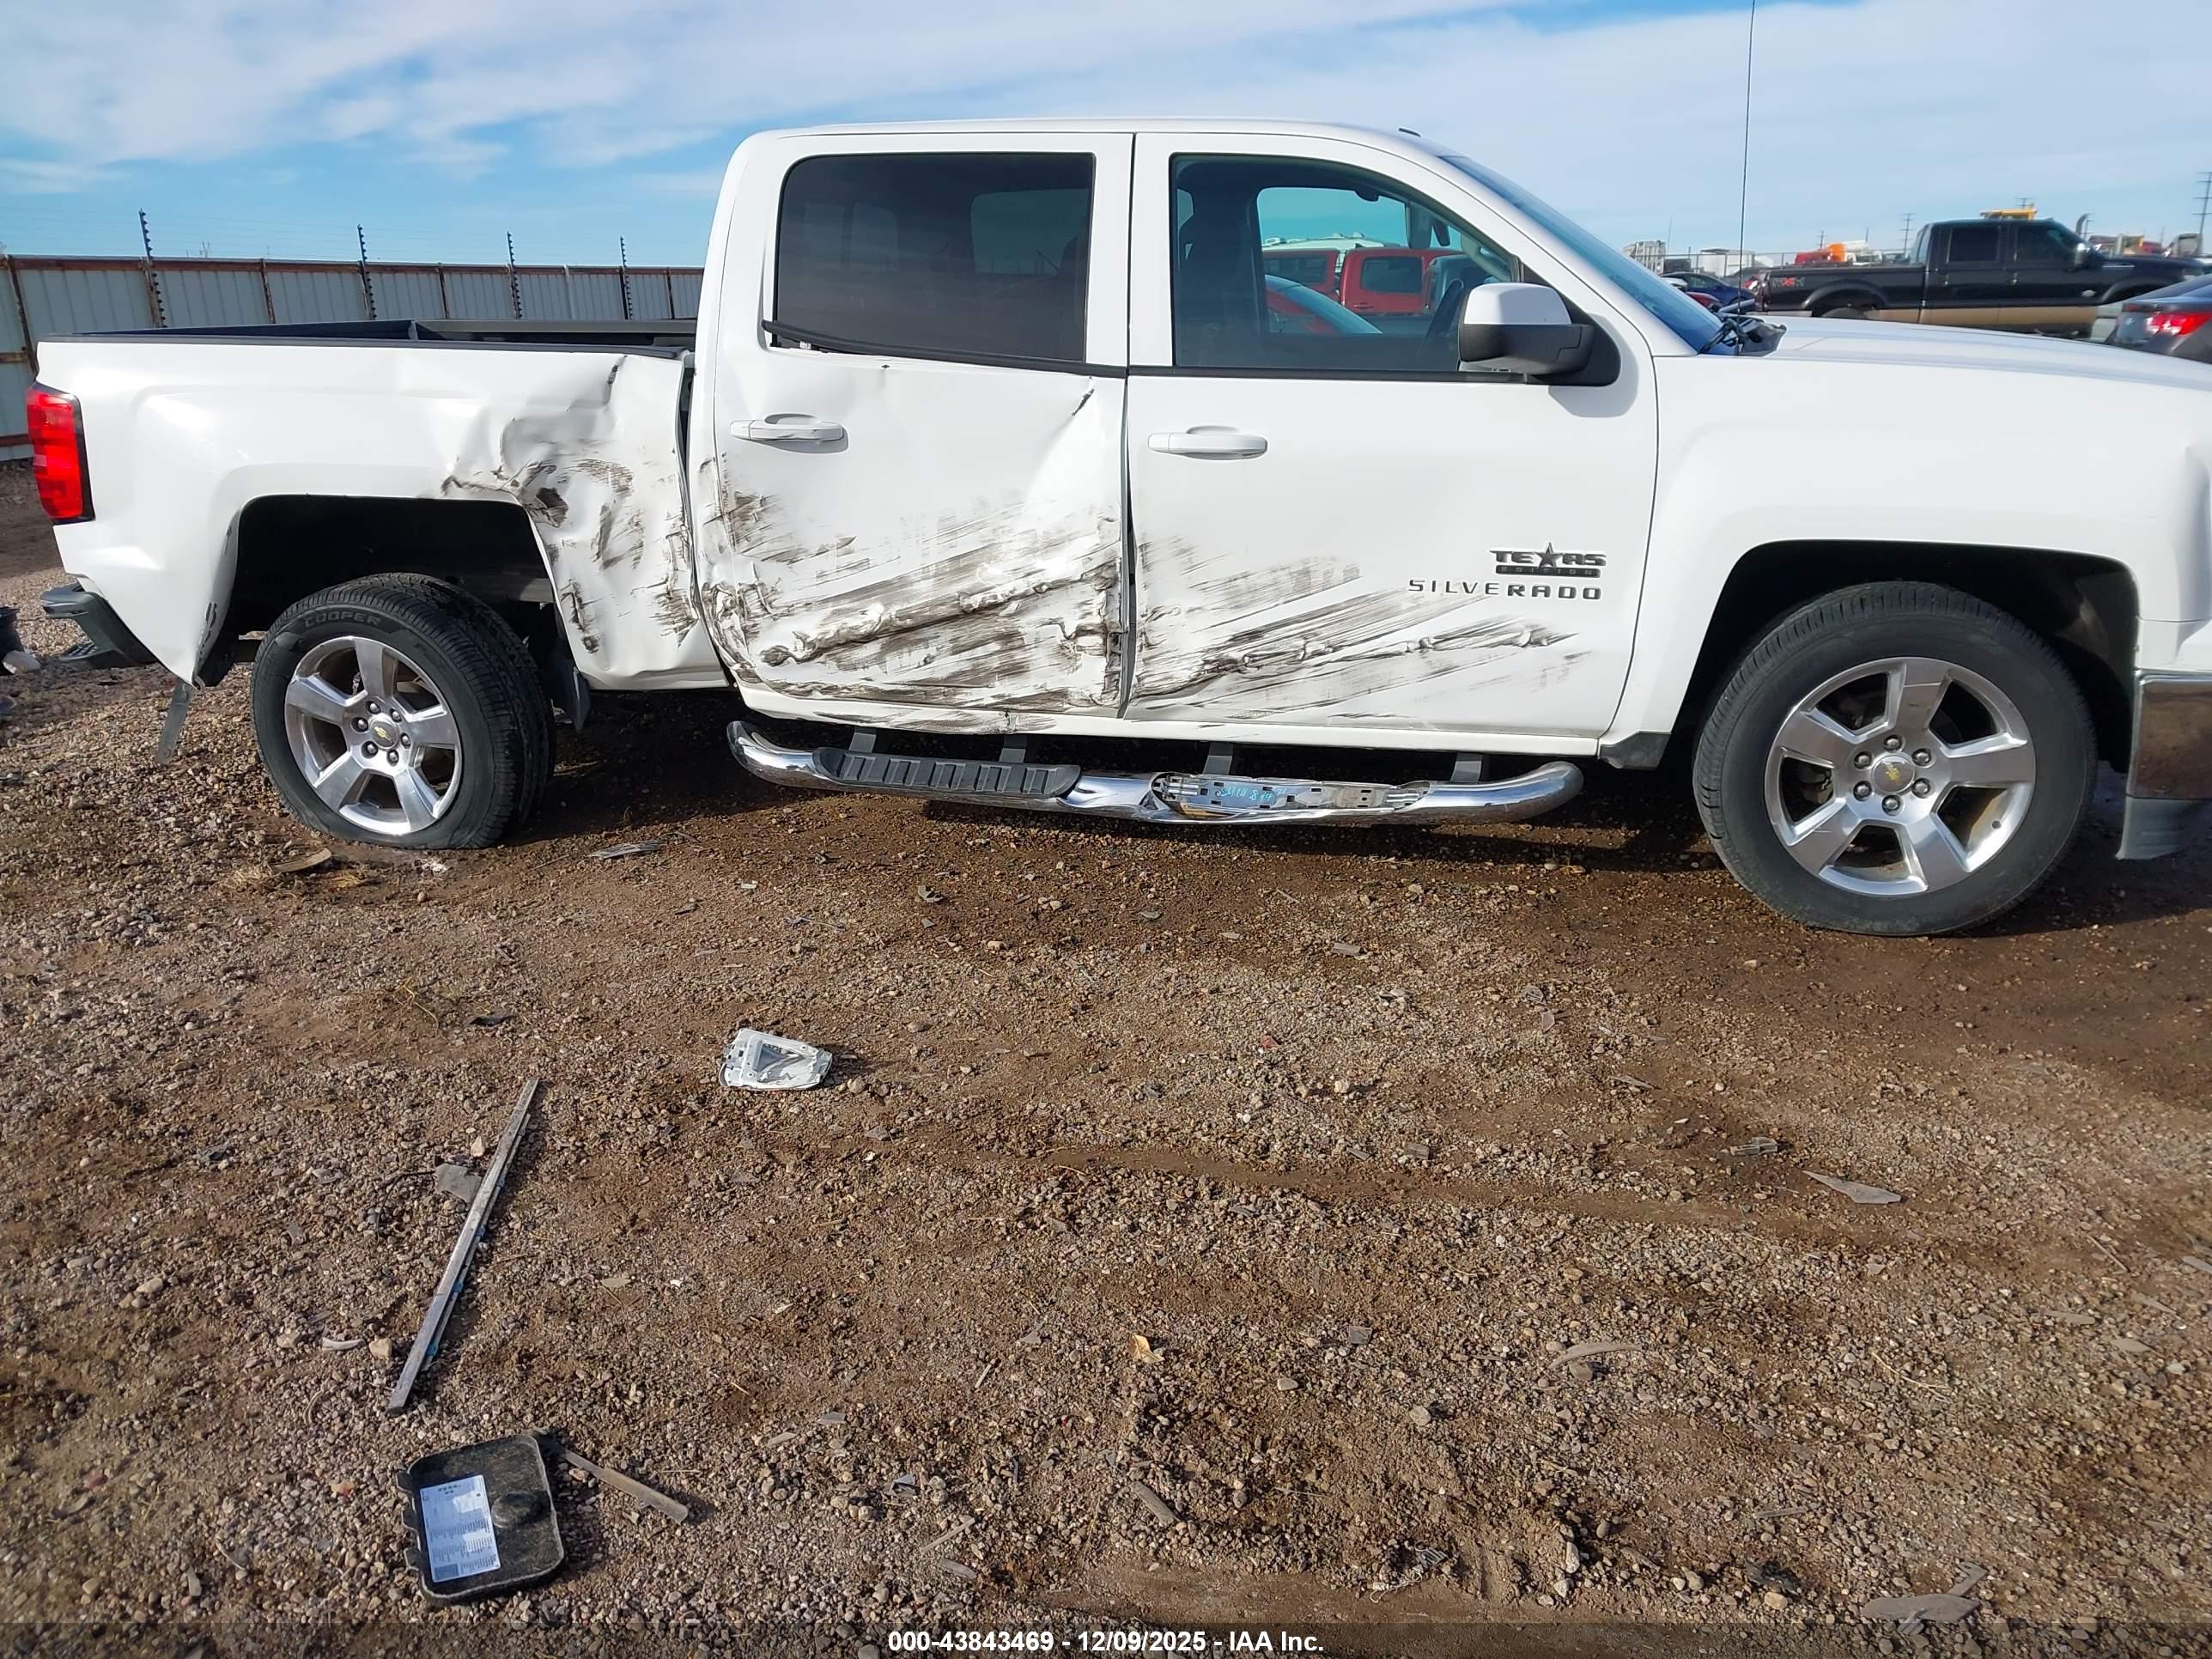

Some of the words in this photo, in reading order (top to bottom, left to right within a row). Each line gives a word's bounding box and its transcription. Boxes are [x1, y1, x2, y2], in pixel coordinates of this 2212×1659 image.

[1499, 565, 1595, 577] EDITION
[1408, 579, 1601, 600] SILVERADO
[304, 611, 381, 628] COOPER
